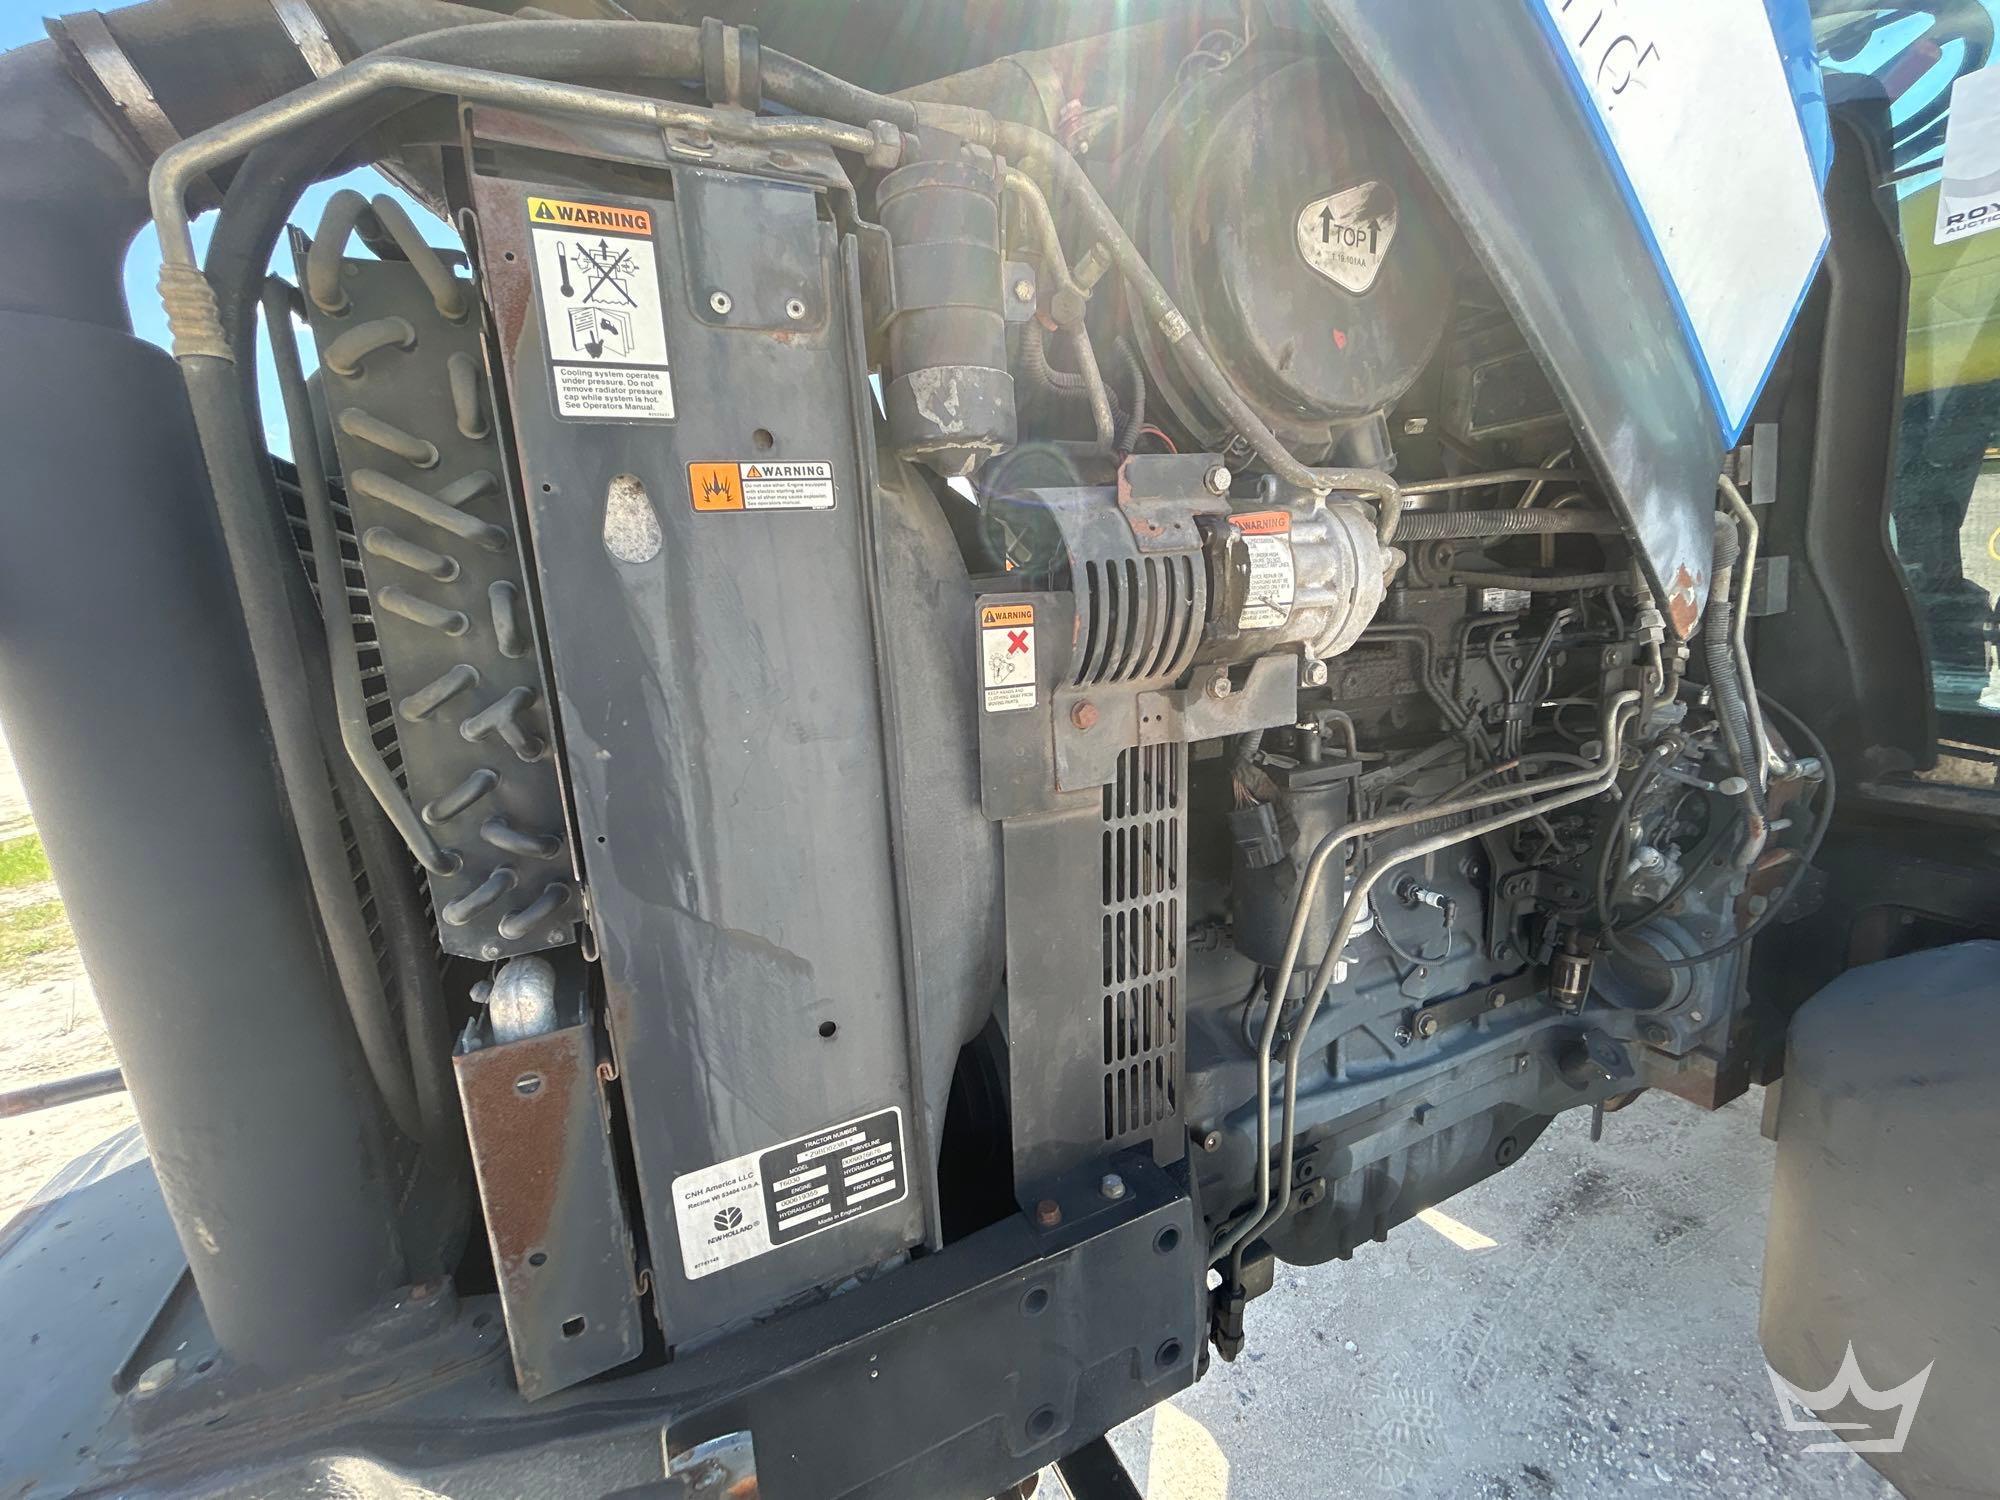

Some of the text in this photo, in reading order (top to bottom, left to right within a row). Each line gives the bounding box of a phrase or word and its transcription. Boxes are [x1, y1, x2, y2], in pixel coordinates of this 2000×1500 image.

[556, 205, 648, 230] WARNING
[1334, 224, 1367, 247] TOP
[560, 368, 660, 380] Cooling system operates
[561, 377, 654, 388] under pressure. Do not
[581, 393, 603, 401] while
[635, 395, 643, 403] is
[644, 396, 660, 404] hot.
[628, 388, 663, 396] pressure
[582, 402, 623, 410] Operators
[624, 403, 655, 411] Manual.
[762, 466, 824, 477] WARNING
[1242, 518, 1286, 531] WARNING
[995, 611, 1032, 620] WARNING
[804, 1126, 858, 1149] TRACTOR NUMBER
[851, 1138, 881, 1153] DRIVELINE
[789, 1163, 809, 1175] MODEL
[843, 1153, 893, 1176] HYDRAULIC PUMP
[684, 1171, 754, 1201] CNH America LLC
[779, 1176, 801, 1189] T6030
[790, 1182, 812, 1195] ENGINE
[853, 1175, 885, 1192] FRONT AXLE
[779, 1197, 825, 1219] HYDRAULIC LIFT
[817, 1215, 833, 1226] Made
[840, 1205, 862, 1218] England
[707, 1223, 753, 1246] NEW HOLLAND
